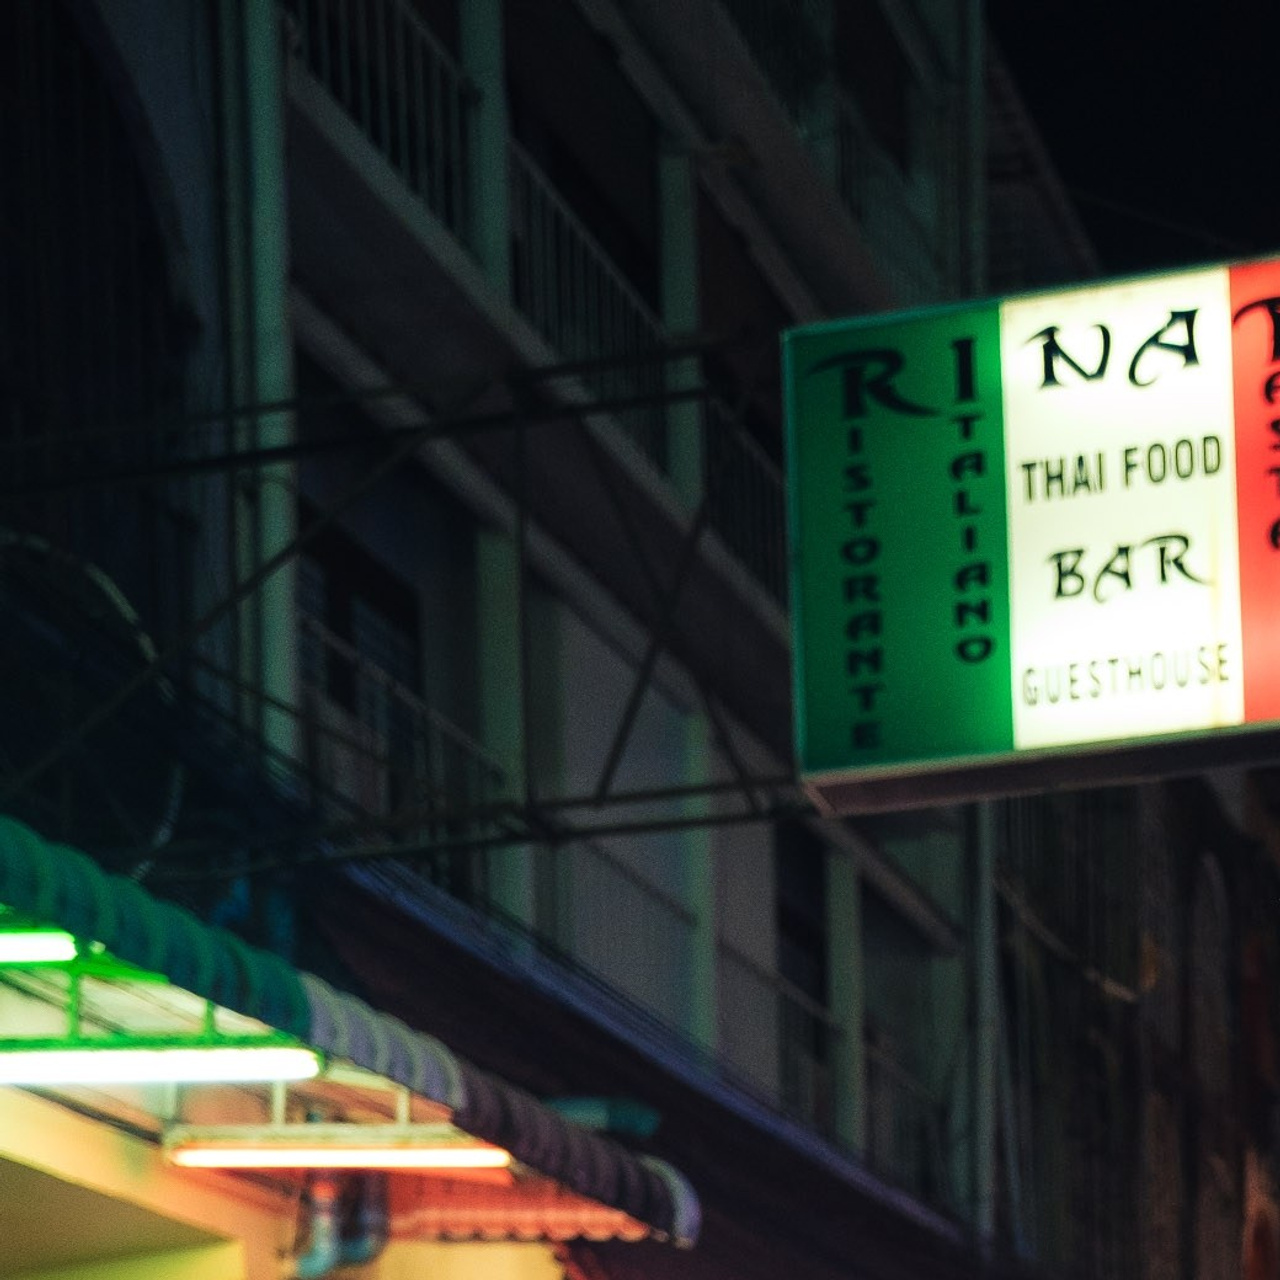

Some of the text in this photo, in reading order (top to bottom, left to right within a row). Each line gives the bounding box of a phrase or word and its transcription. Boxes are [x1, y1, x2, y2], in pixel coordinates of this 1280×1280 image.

[948, 336, 996, 665] ITALIANO
[1020, 434, 1222, 503] THAI FOOD
[804, 347, 942, 752] RISTORANTE
[1045, 533, 1214, 603] BAR
[1021, 641, 1230, 708] GUESTHOUSE
